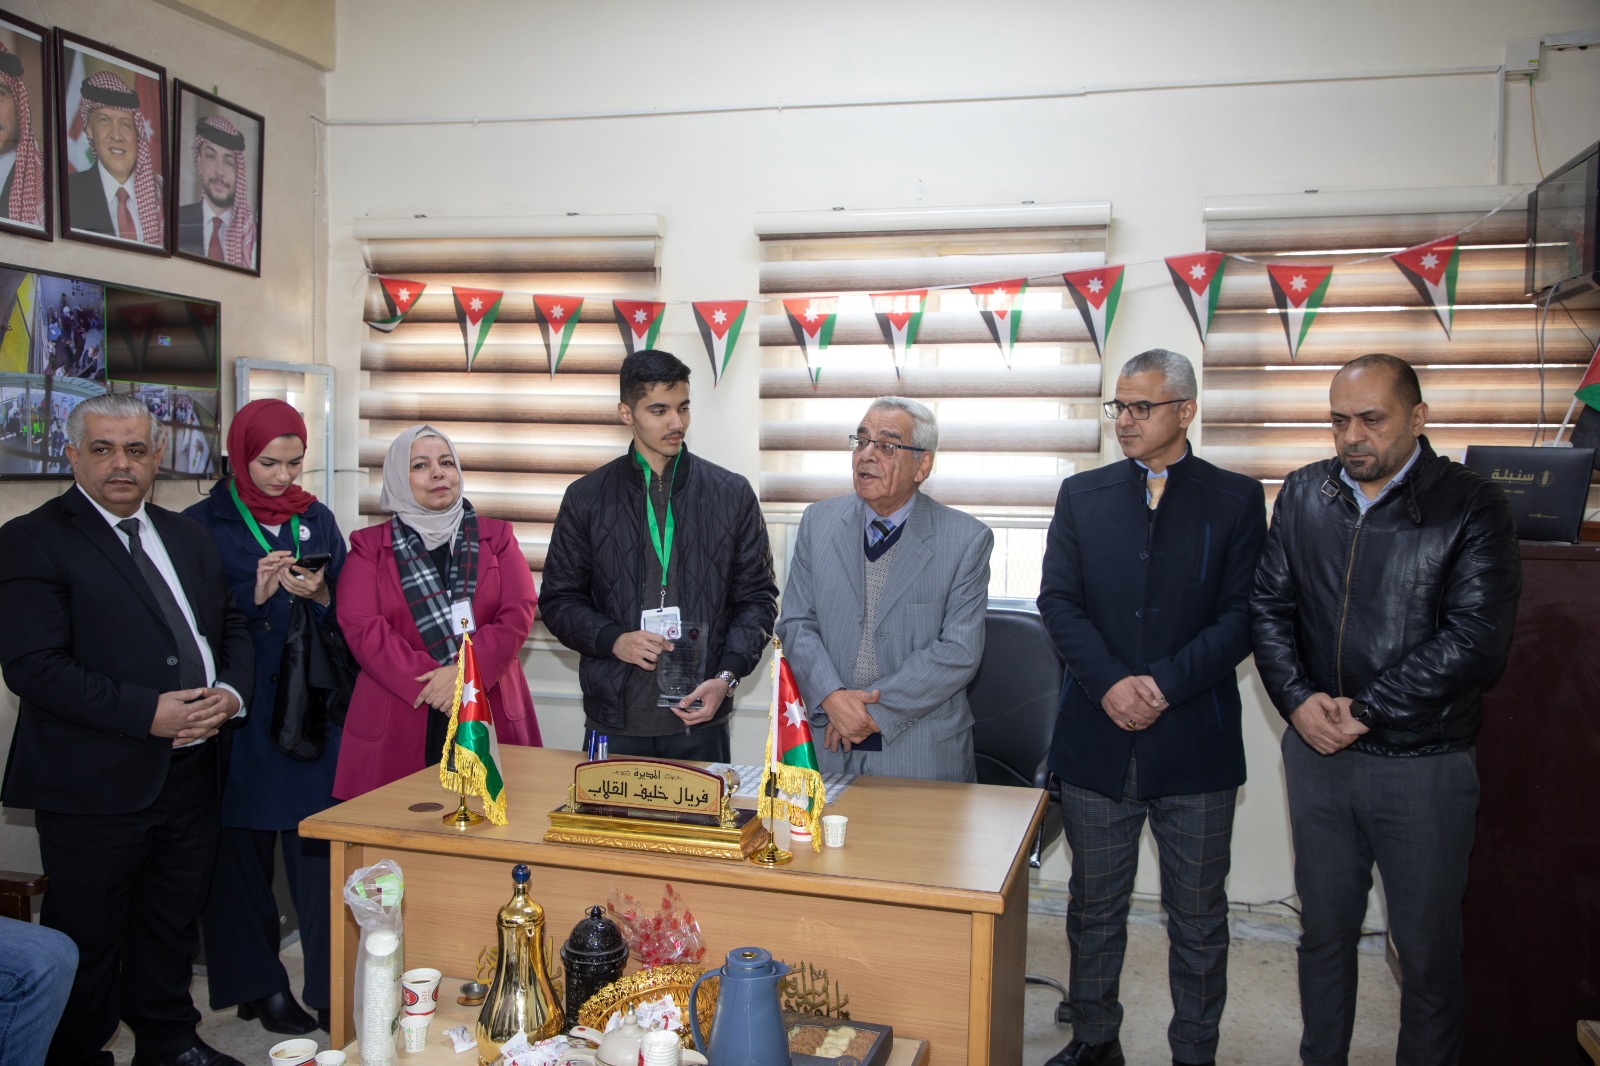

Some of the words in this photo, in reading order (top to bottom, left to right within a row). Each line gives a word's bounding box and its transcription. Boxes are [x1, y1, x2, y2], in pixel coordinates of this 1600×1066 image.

[1491, 468, 1535, 481] سنبلة
[633, 767, 661, 780] المديرة
[587, 779, 628, 800] القلاب
[633, 783, 669, 801] خليف
[673, 786, 709, 807] فريال
